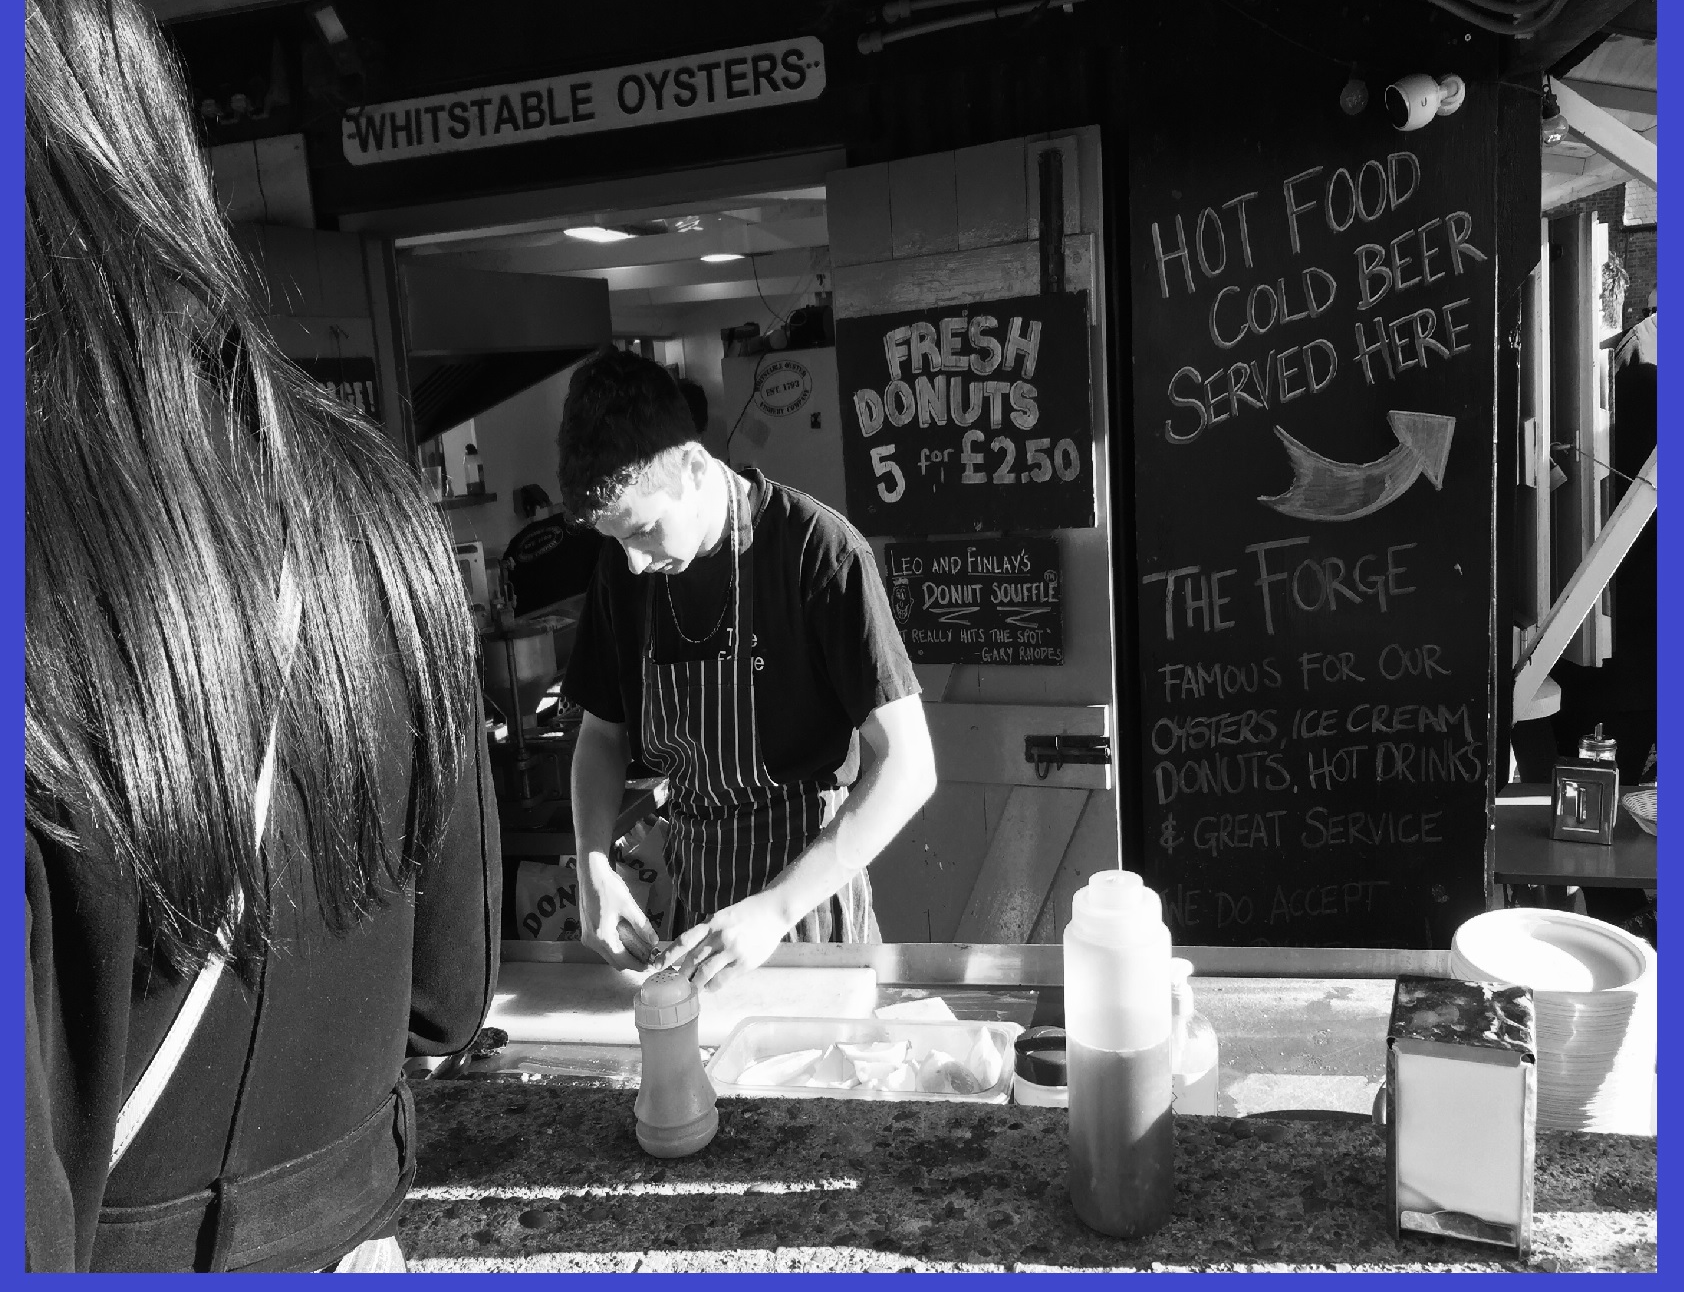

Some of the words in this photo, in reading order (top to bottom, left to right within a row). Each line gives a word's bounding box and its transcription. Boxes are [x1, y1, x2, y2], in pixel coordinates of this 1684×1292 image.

[353, 81, 595, 154] WHITSTABLE
[617, 49, 807, 117] OYSTERS
[1151, 191, 1259, 299] HOT
[1283, 151, 1421, 254] FOOD
[1208, 266, 1338, 350] COLD
[1353, 210, 1488, 310] BEER
[883, 315, 1042, 380] FRESH
[1164, 338, 1338, 445] SERVED
[1353, 297, 1472, 385] HERE
[853, 375, 1040, 438] DONUTS
[869, 444, 906, 504] 5
[917, 448, 954, 476] for
[960, 429, 1080, 485] £2.50
[890, 550, 923, 576] LEO
[932, 556, 961, 575] AND
[966, 547, 1031, 574] FINLAY'S
[1142, 564, 1238, 641] THE
[1245, 535, 1418, 636] FORGE
[921, 581, 983, 610] DONUT
[990, 581, 1059, 604] SOUFFLE
[911, 628, 953, 643] REALLY
[960, 628, 985, 643] HITS
[989, 628, 1013, 643] THE
[1019, 646, 1062, 661] RHODES
[1158, 656, 1283, 703] FAMOUS
[1299, 651, 1366, 691] FOR
[1378, 643, 1452, 681] OUR
[1292, 708, 1339, 741] ICE
[1345, 703, 1475, 744] CREAM
[1308, 745, 1369, 791] HOT
[1375, 740, 1484, 784] DRINKS
[1192, 809, 1288, 858] GREAT
[1300, 806, 1443, 850] SERVICE
[1215, 890, 1254, 929] DO
[1269, 881, 1391, 926] ACCEPT
